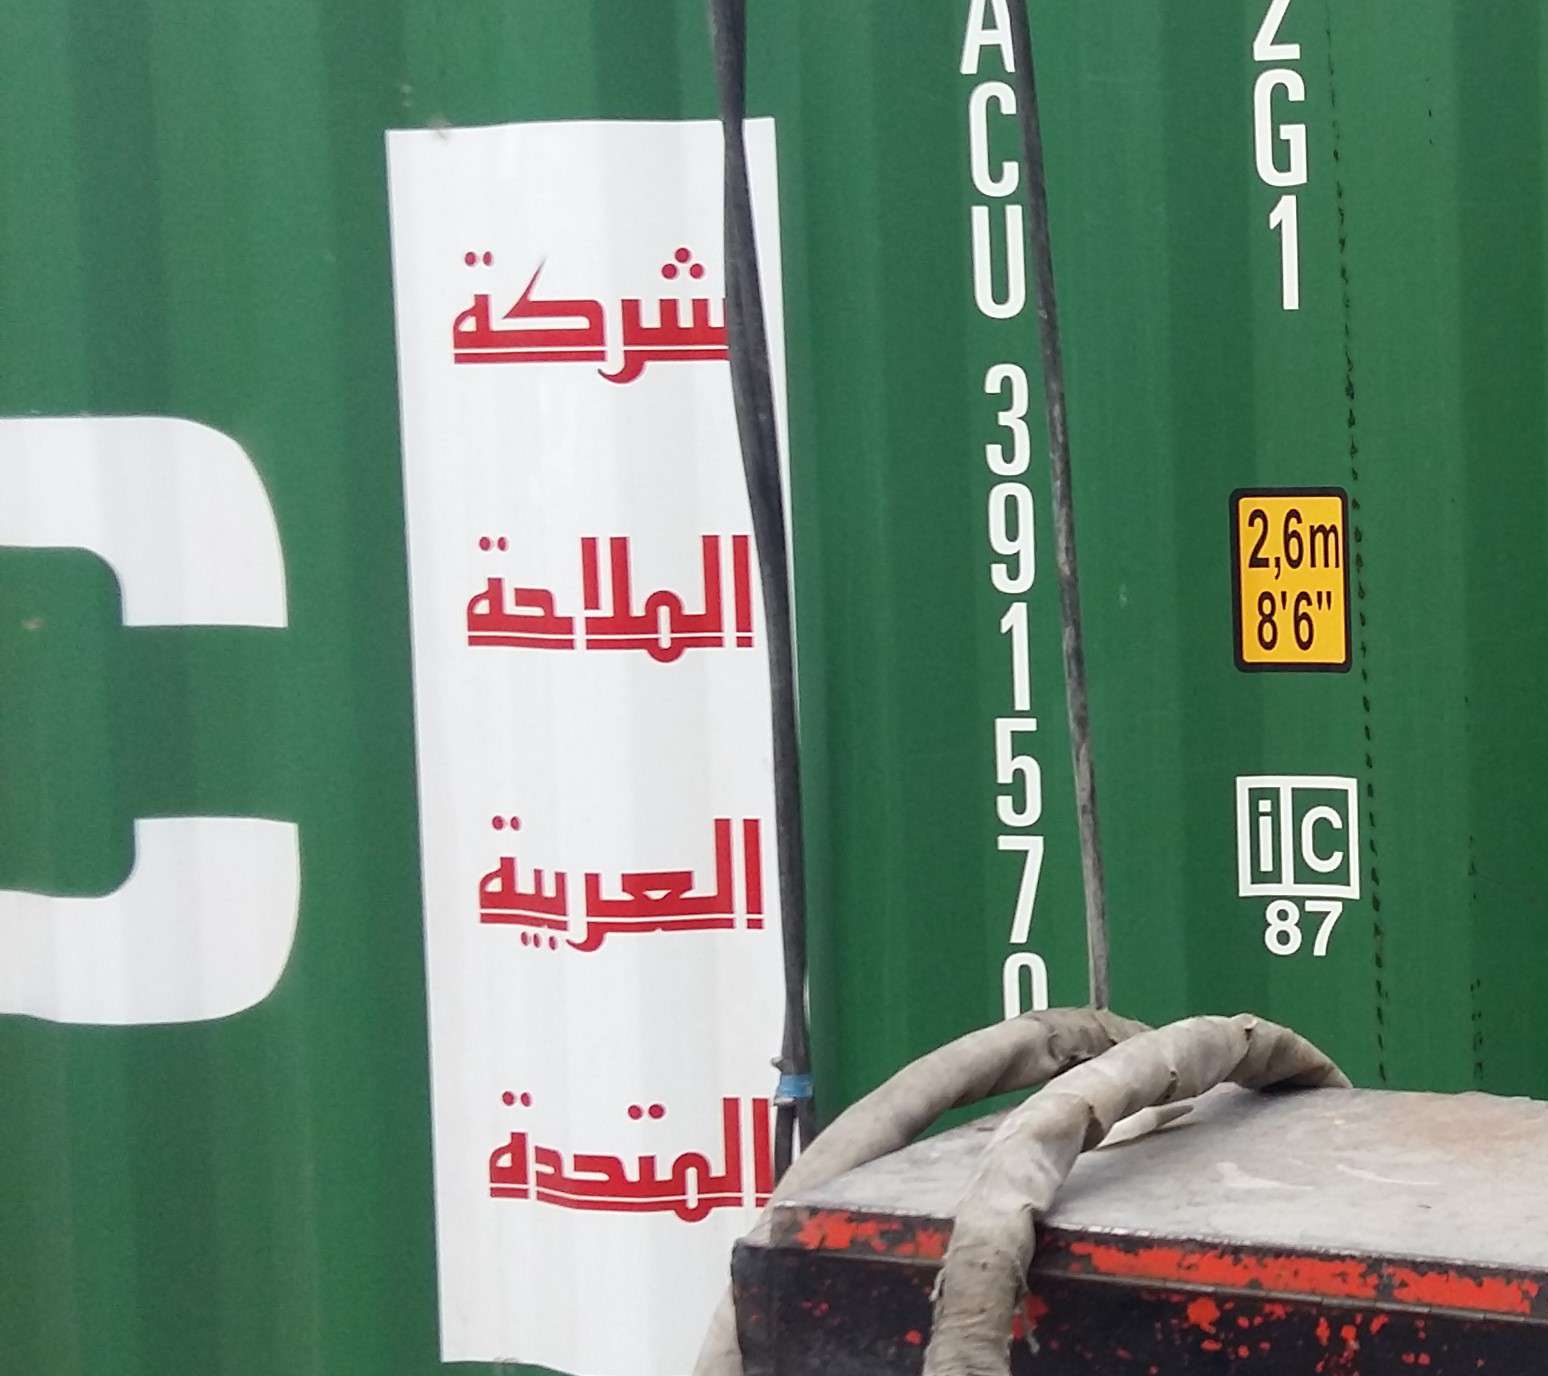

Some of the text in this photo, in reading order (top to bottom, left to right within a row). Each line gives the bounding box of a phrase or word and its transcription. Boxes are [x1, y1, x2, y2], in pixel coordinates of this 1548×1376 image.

[452, 248, 729, 384] شركة
[466, 533, 754, 663] الملاحة
[1247, 508, 1340, 580] 2,6m
[479, 815, 764, 952] العربية
[1264, 900, 1344, 957] 87
[489, 1090, 774, 1223] المتحدة
